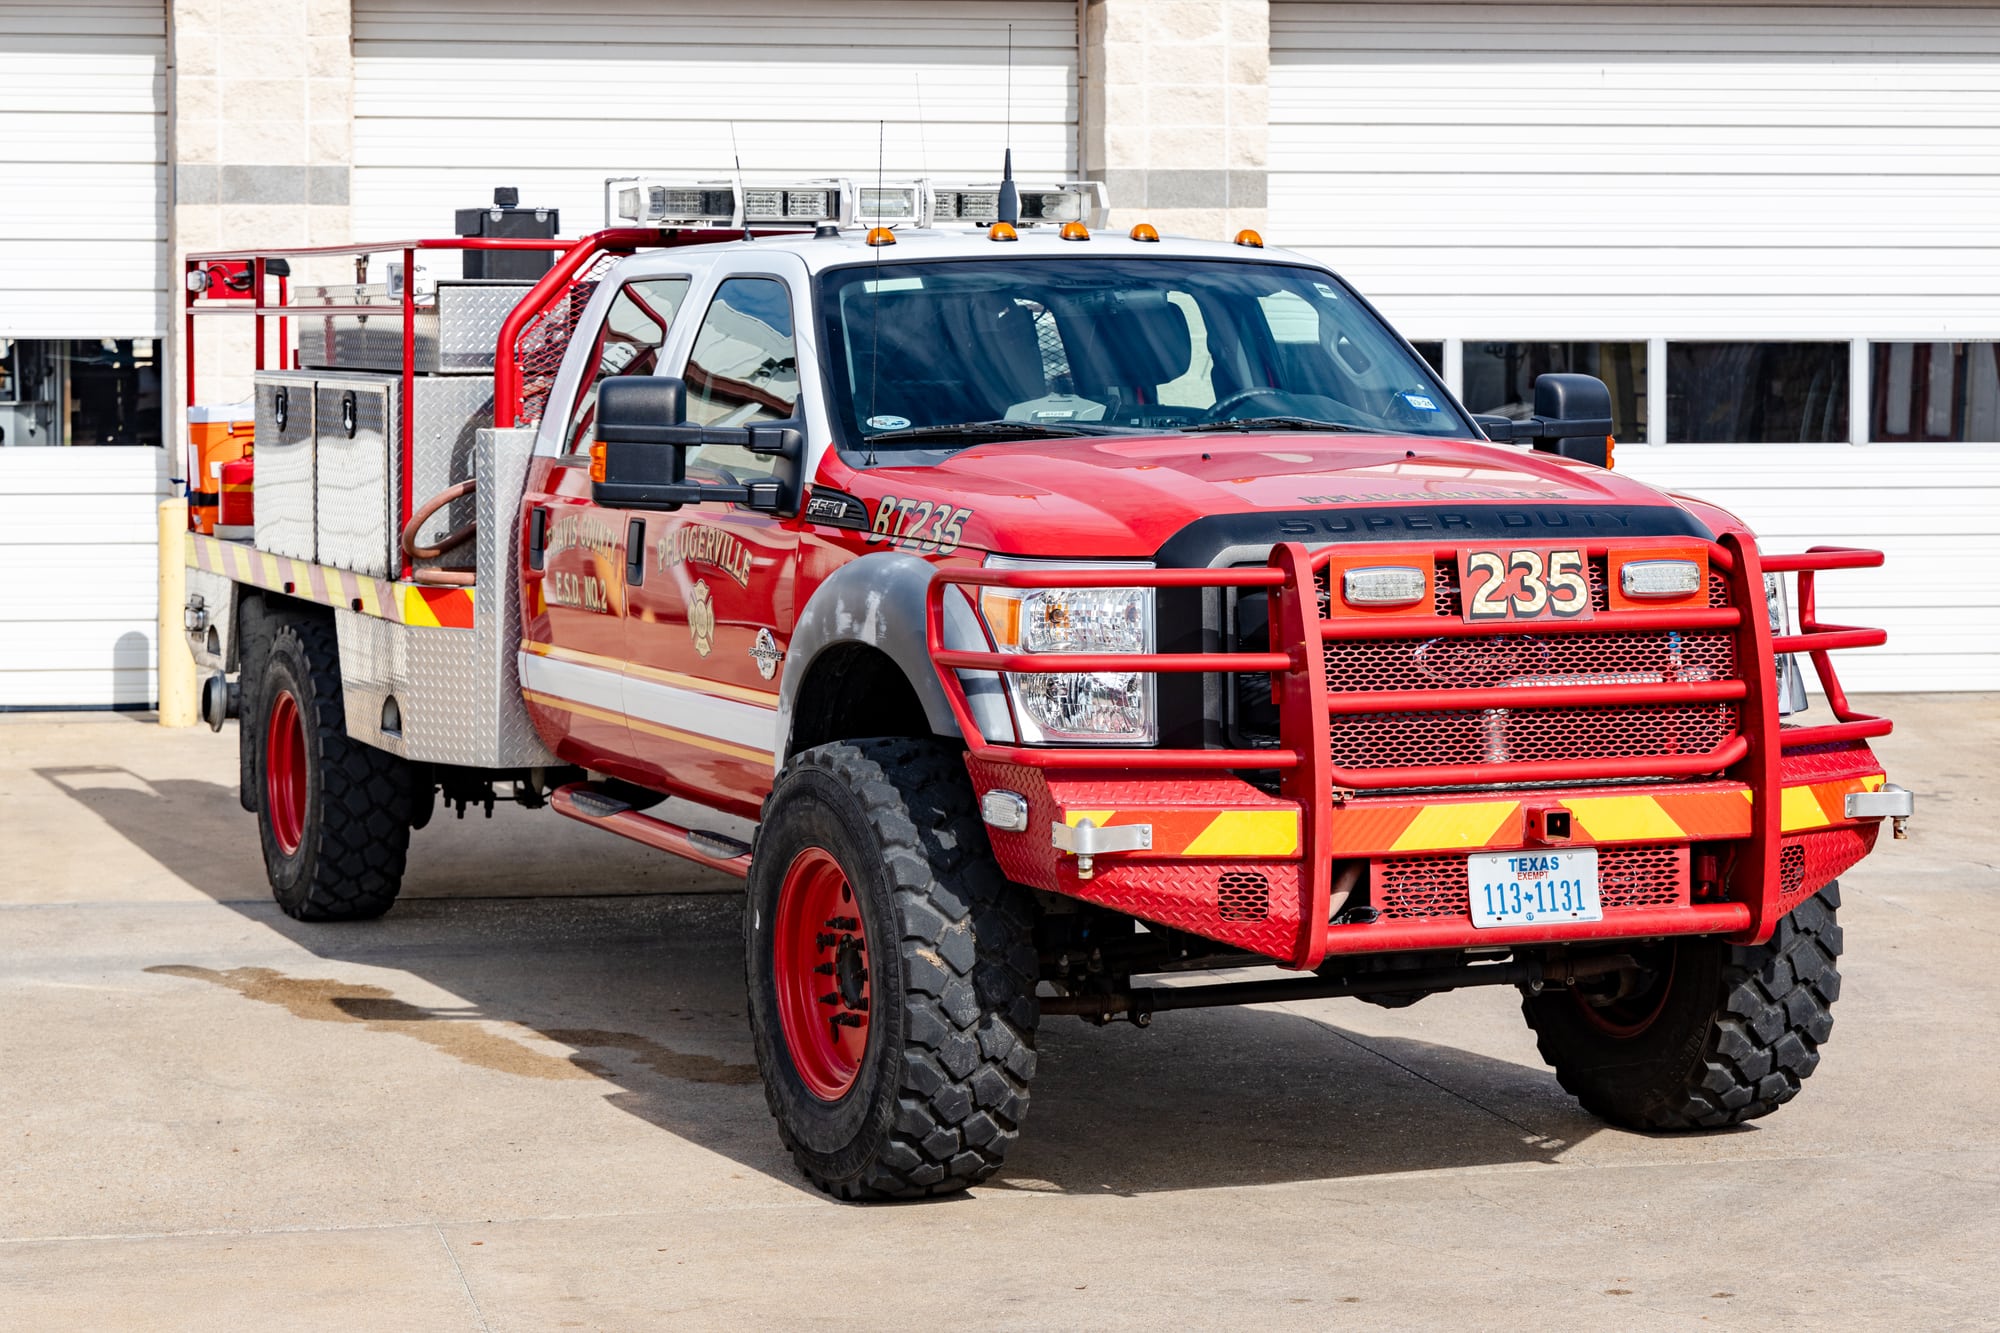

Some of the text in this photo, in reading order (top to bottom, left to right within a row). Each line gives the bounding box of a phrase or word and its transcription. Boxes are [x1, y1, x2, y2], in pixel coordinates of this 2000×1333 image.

[805, 498, 848, 519] F-550
[865, 494, 975, 557] BT235
[1278, 511, 1633, 534] SUPER DUTY
[546, 511, 619, 567] TRAVIS COUNTY
[656, 524, 753, 590] PFLUGERVILLE
[555, 571, 582, 608] E.S.D.
[1467, 550, 1589, 620] 235
[1508, 856, 1560, 873] TEXAS
[1517, 870, 1549, 881] EXEMPT
